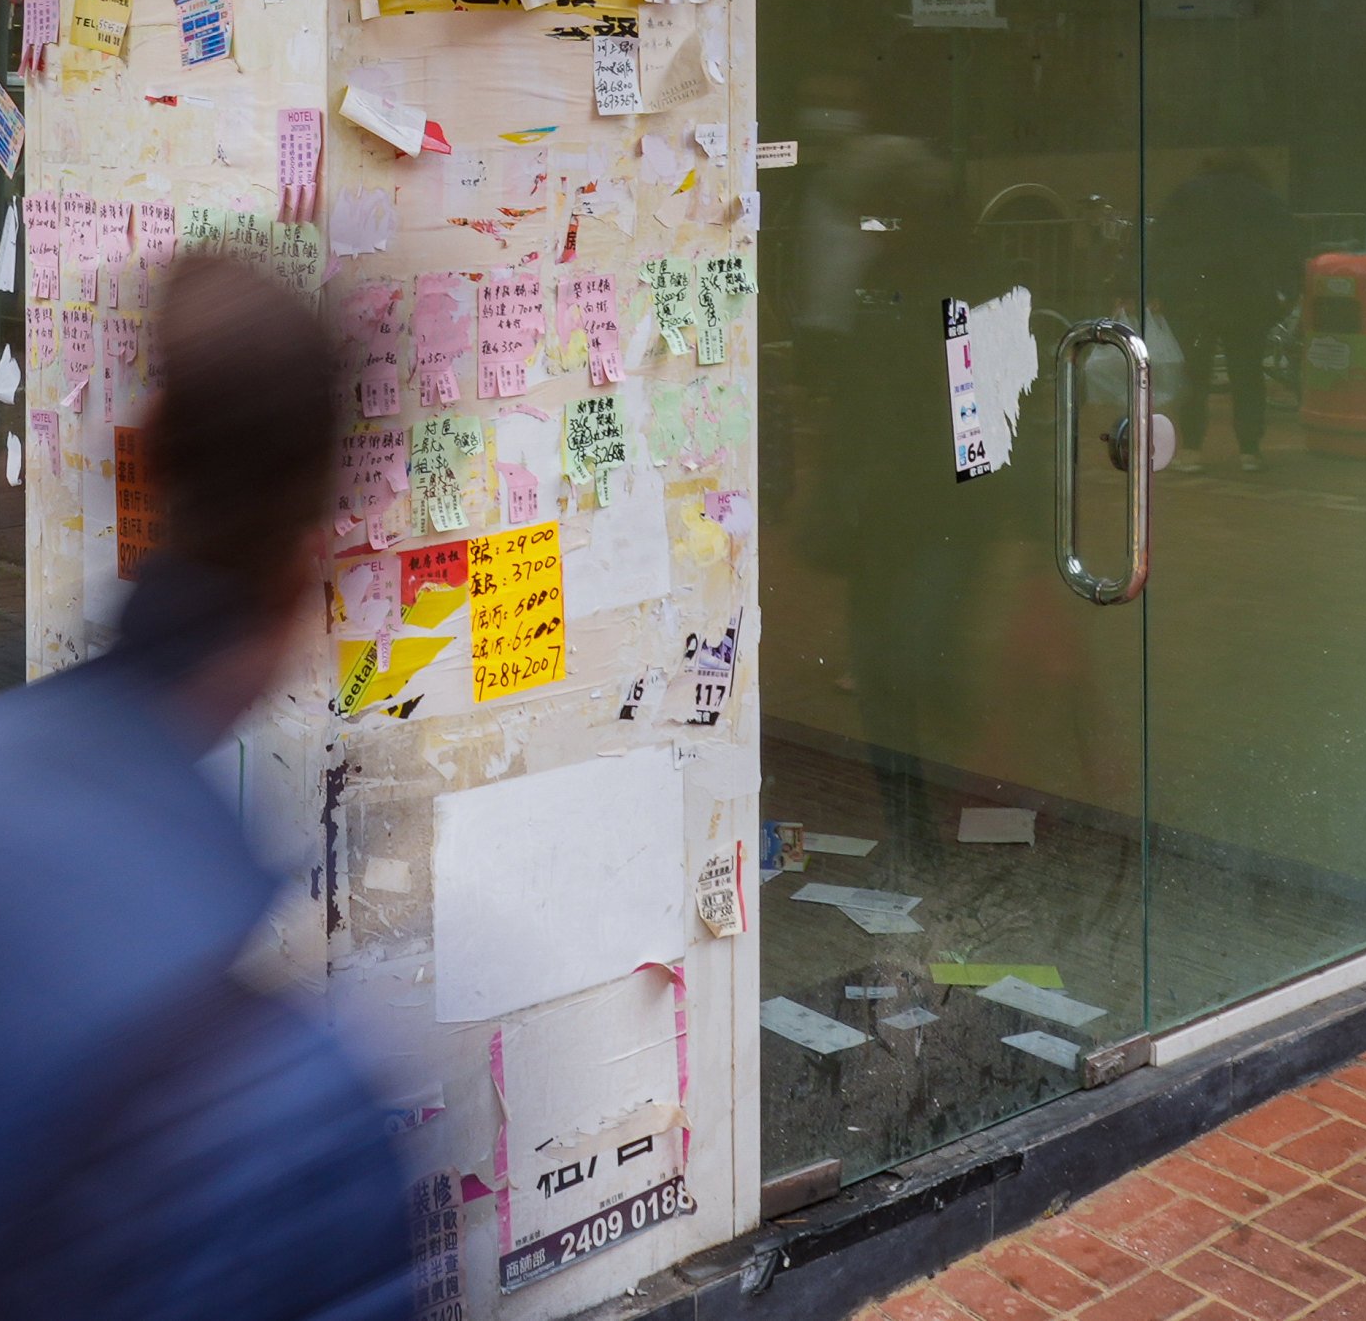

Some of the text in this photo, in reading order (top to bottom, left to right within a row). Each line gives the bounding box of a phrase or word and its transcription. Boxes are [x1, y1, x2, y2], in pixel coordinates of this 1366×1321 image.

[288, 112, 314, 122] HOTEL
[32, 412, 53, 424] HOTEL
[506, 529, 554, 554] 2900
[512, 555, 557, 582] 3700
[474, 645, 561, 702] 92842007
[559, 1210, 624, 1265] 2409
[630, 1182, 695, 1230] 0188
